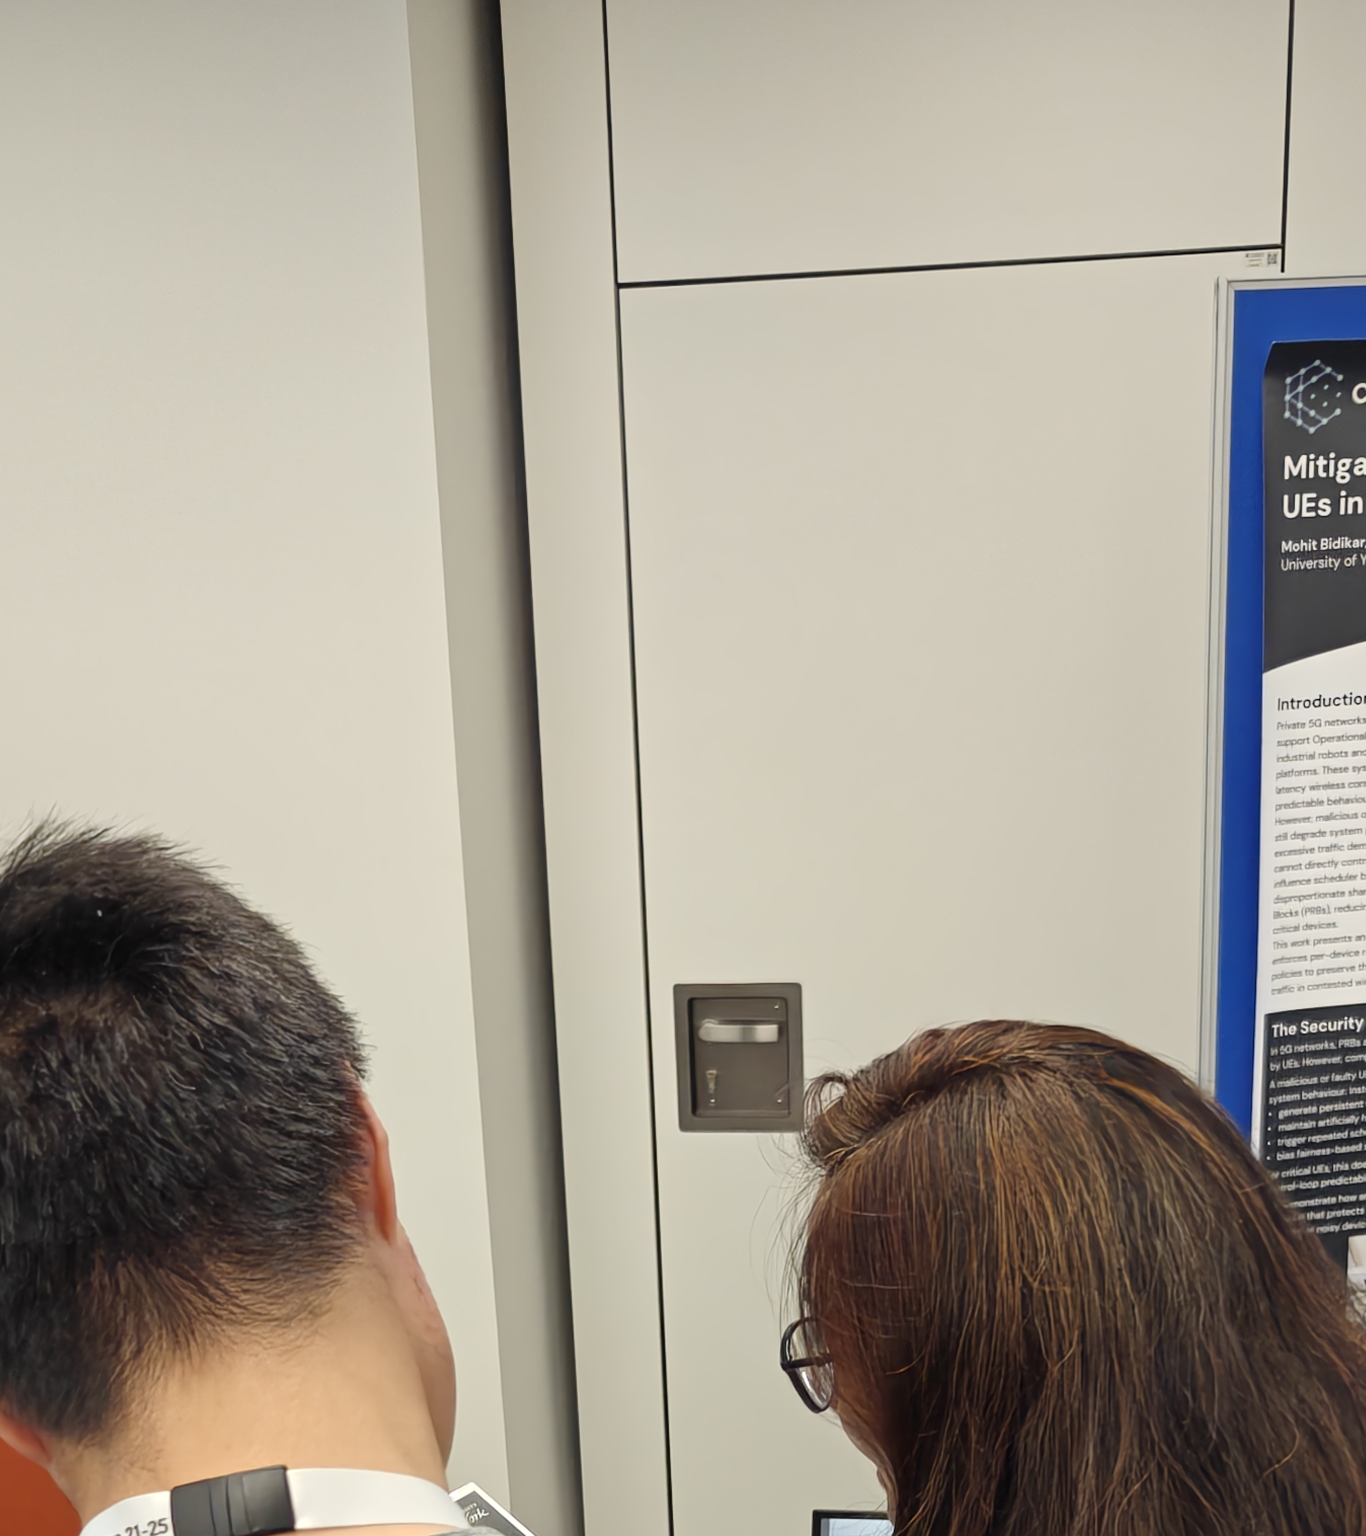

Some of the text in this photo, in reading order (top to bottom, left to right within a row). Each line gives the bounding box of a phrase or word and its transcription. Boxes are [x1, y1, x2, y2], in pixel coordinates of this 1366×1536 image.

[1283, 493, 1331, 518] UEs
[1339, 490, 1363, 515] in
[1281, 539, 1317, 553] Mohit
[1281, 555, 1341, 571] University
[1344, 553, 1357, 567] of
[1272, 1023, 1297, 1038] The
[1300, 1016, 1364, 1034] Security
